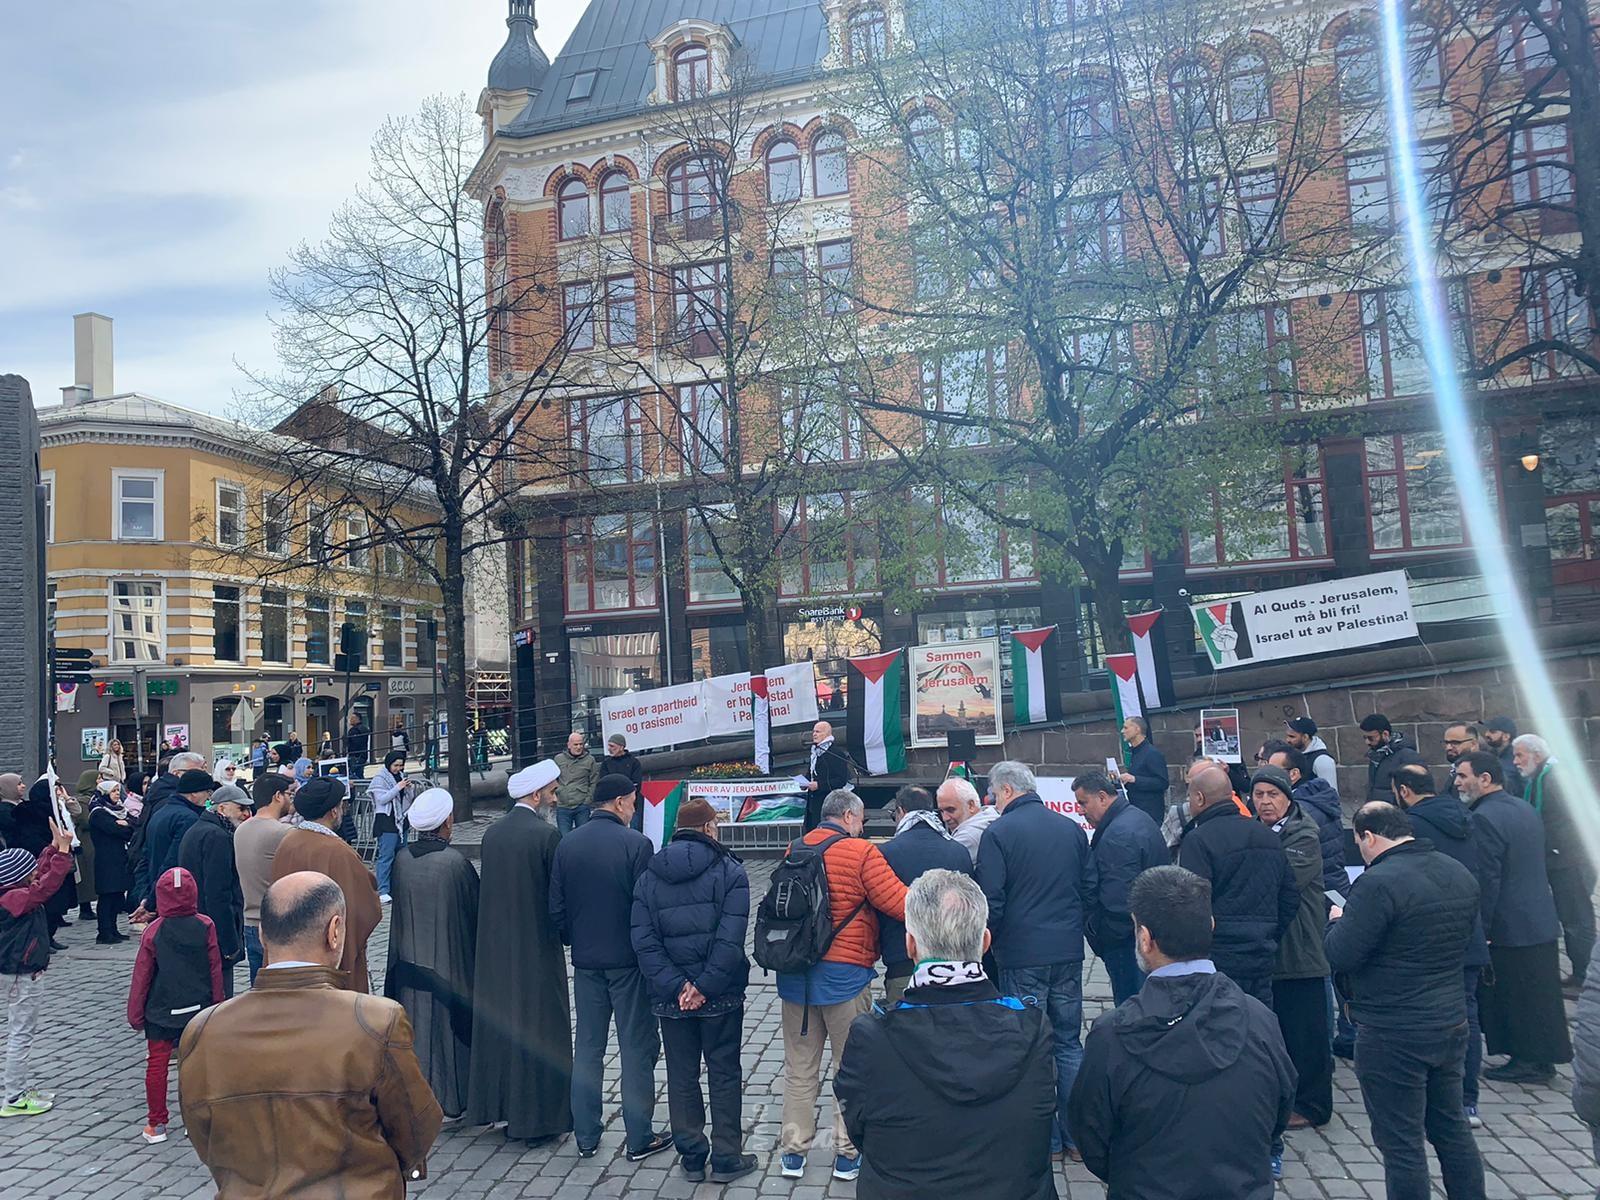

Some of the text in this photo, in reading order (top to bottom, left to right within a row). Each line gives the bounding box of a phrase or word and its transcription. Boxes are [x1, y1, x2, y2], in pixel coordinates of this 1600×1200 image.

[1254, 604, 1267, 615] Al
[1271, 599, 1306, 612] Quds
[1319, 586, 1398, 605] Jerusalem,
[1294, 604, 1361, 623] må bli fri!
[1256, 611, 1408, 644] Israel ut av Palestina!
[926, 650, 982, 662] Sammen
[944, 664, 967, 675] for
[924, 675, 988, 688] Jerusalem
[608, 695, 698, 721] Israel er apartheid
[726, 699, 737, 709] er
[626, 713, 683, 734] og rasisme!
[733, 784, 777, 793] JERUSALEM
